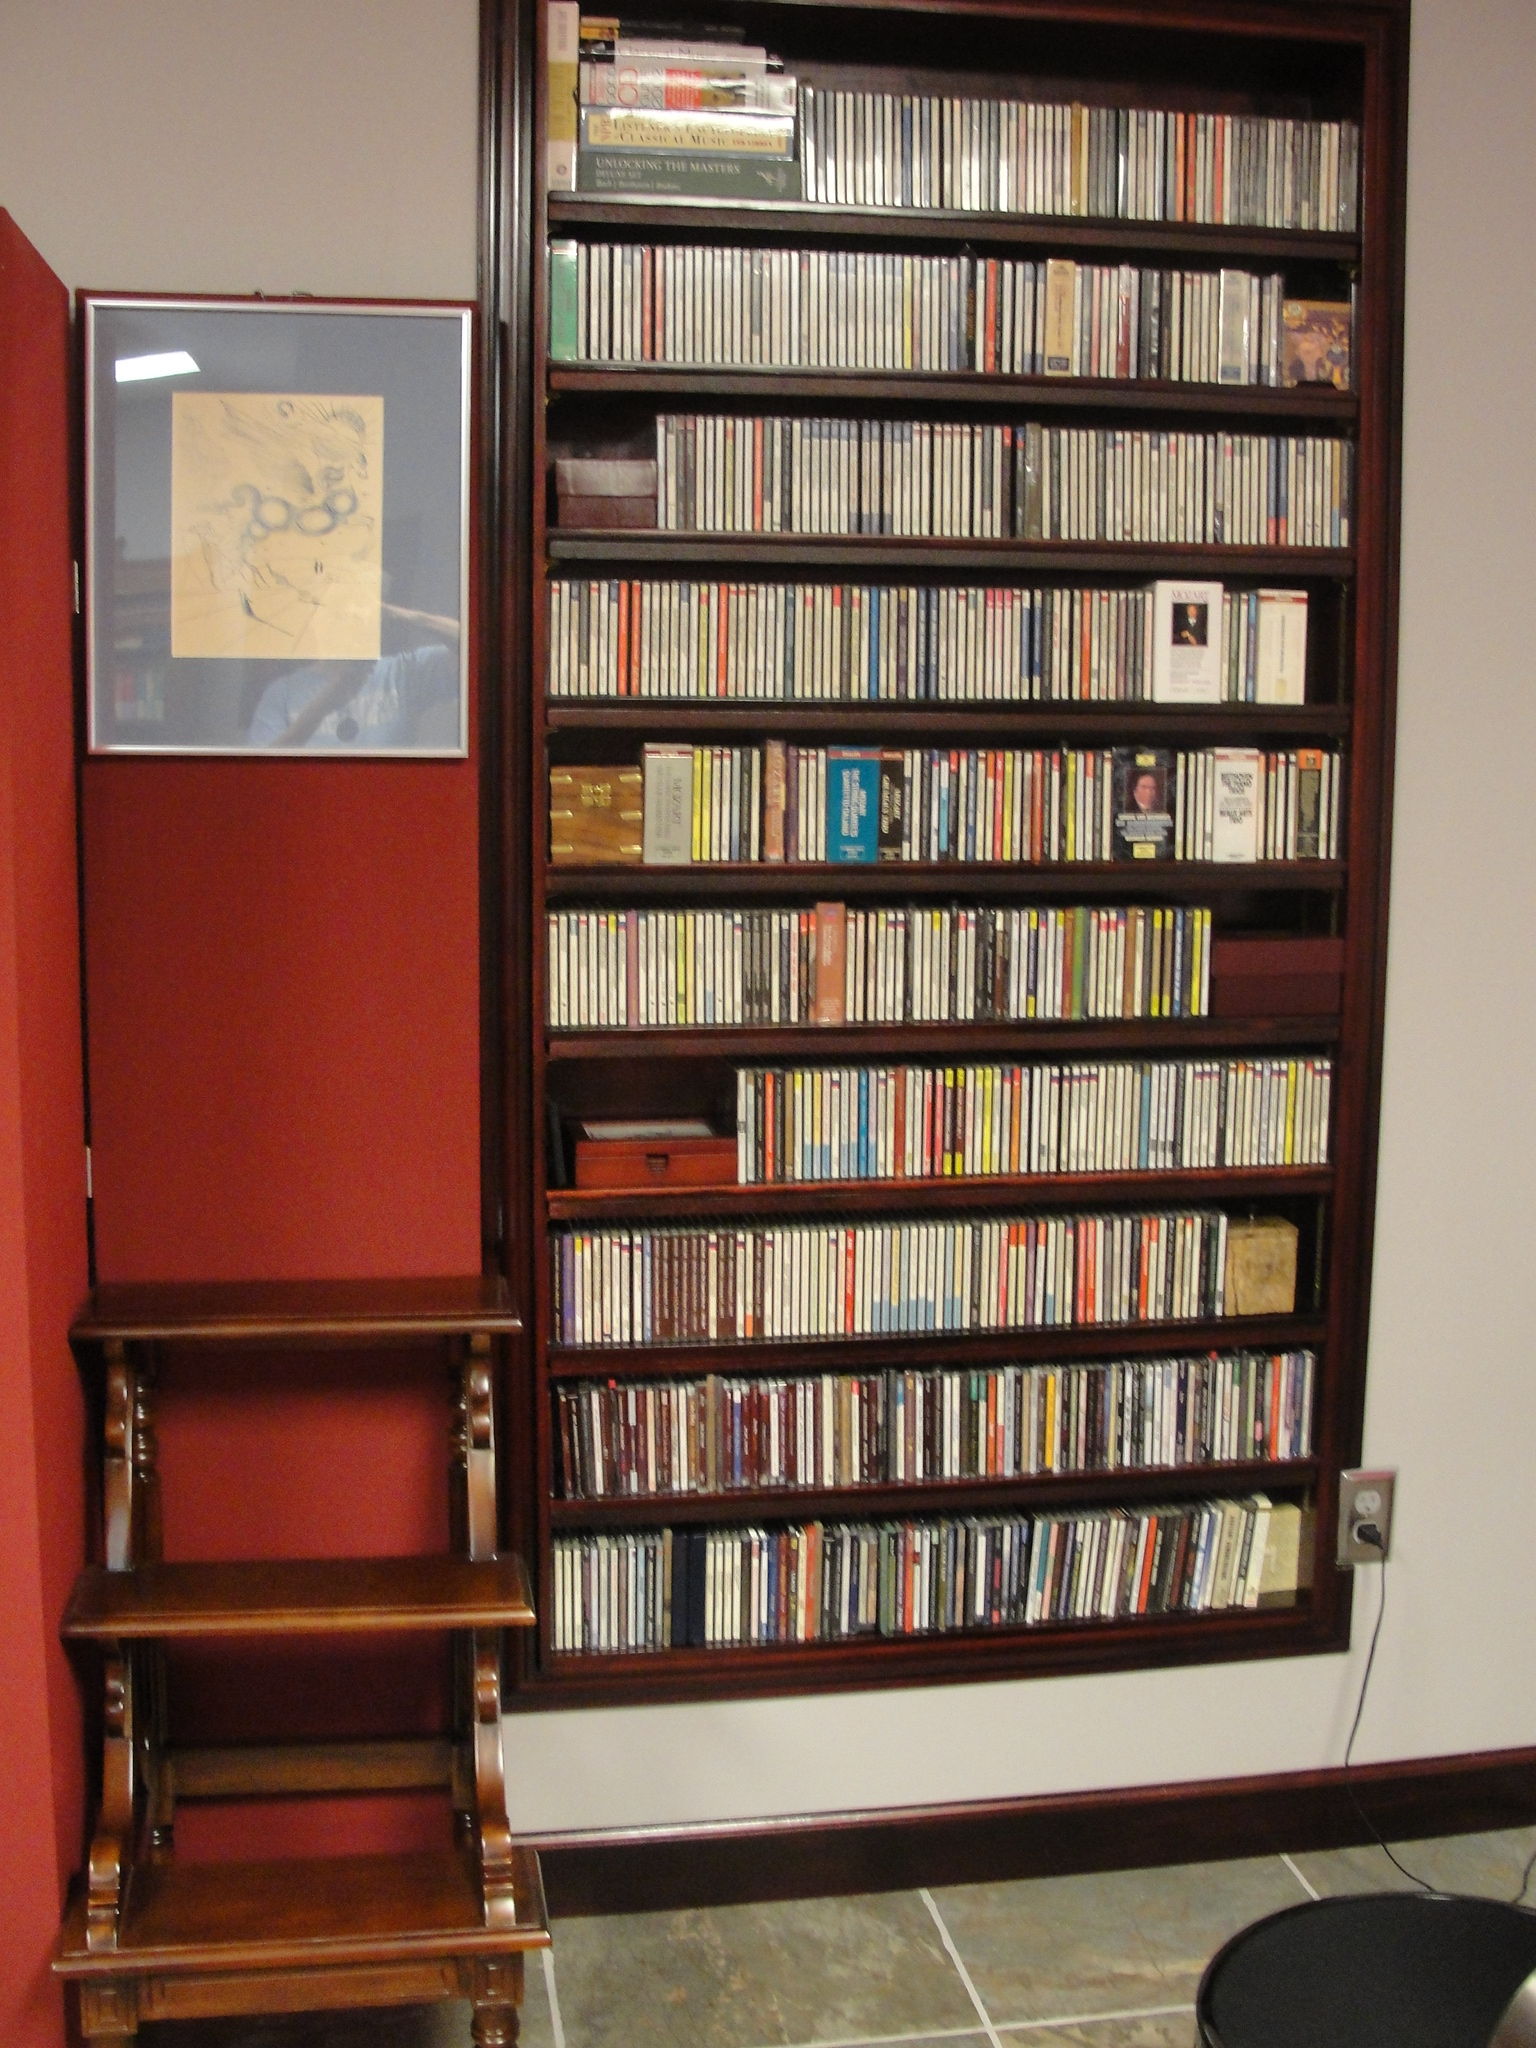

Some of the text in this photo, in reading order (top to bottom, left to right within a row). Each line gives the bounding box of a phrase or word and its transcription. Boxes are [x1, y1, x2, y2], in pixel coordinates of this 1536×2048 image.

[596, 157, 741, 176] UNLOCKING THE MASTERS
